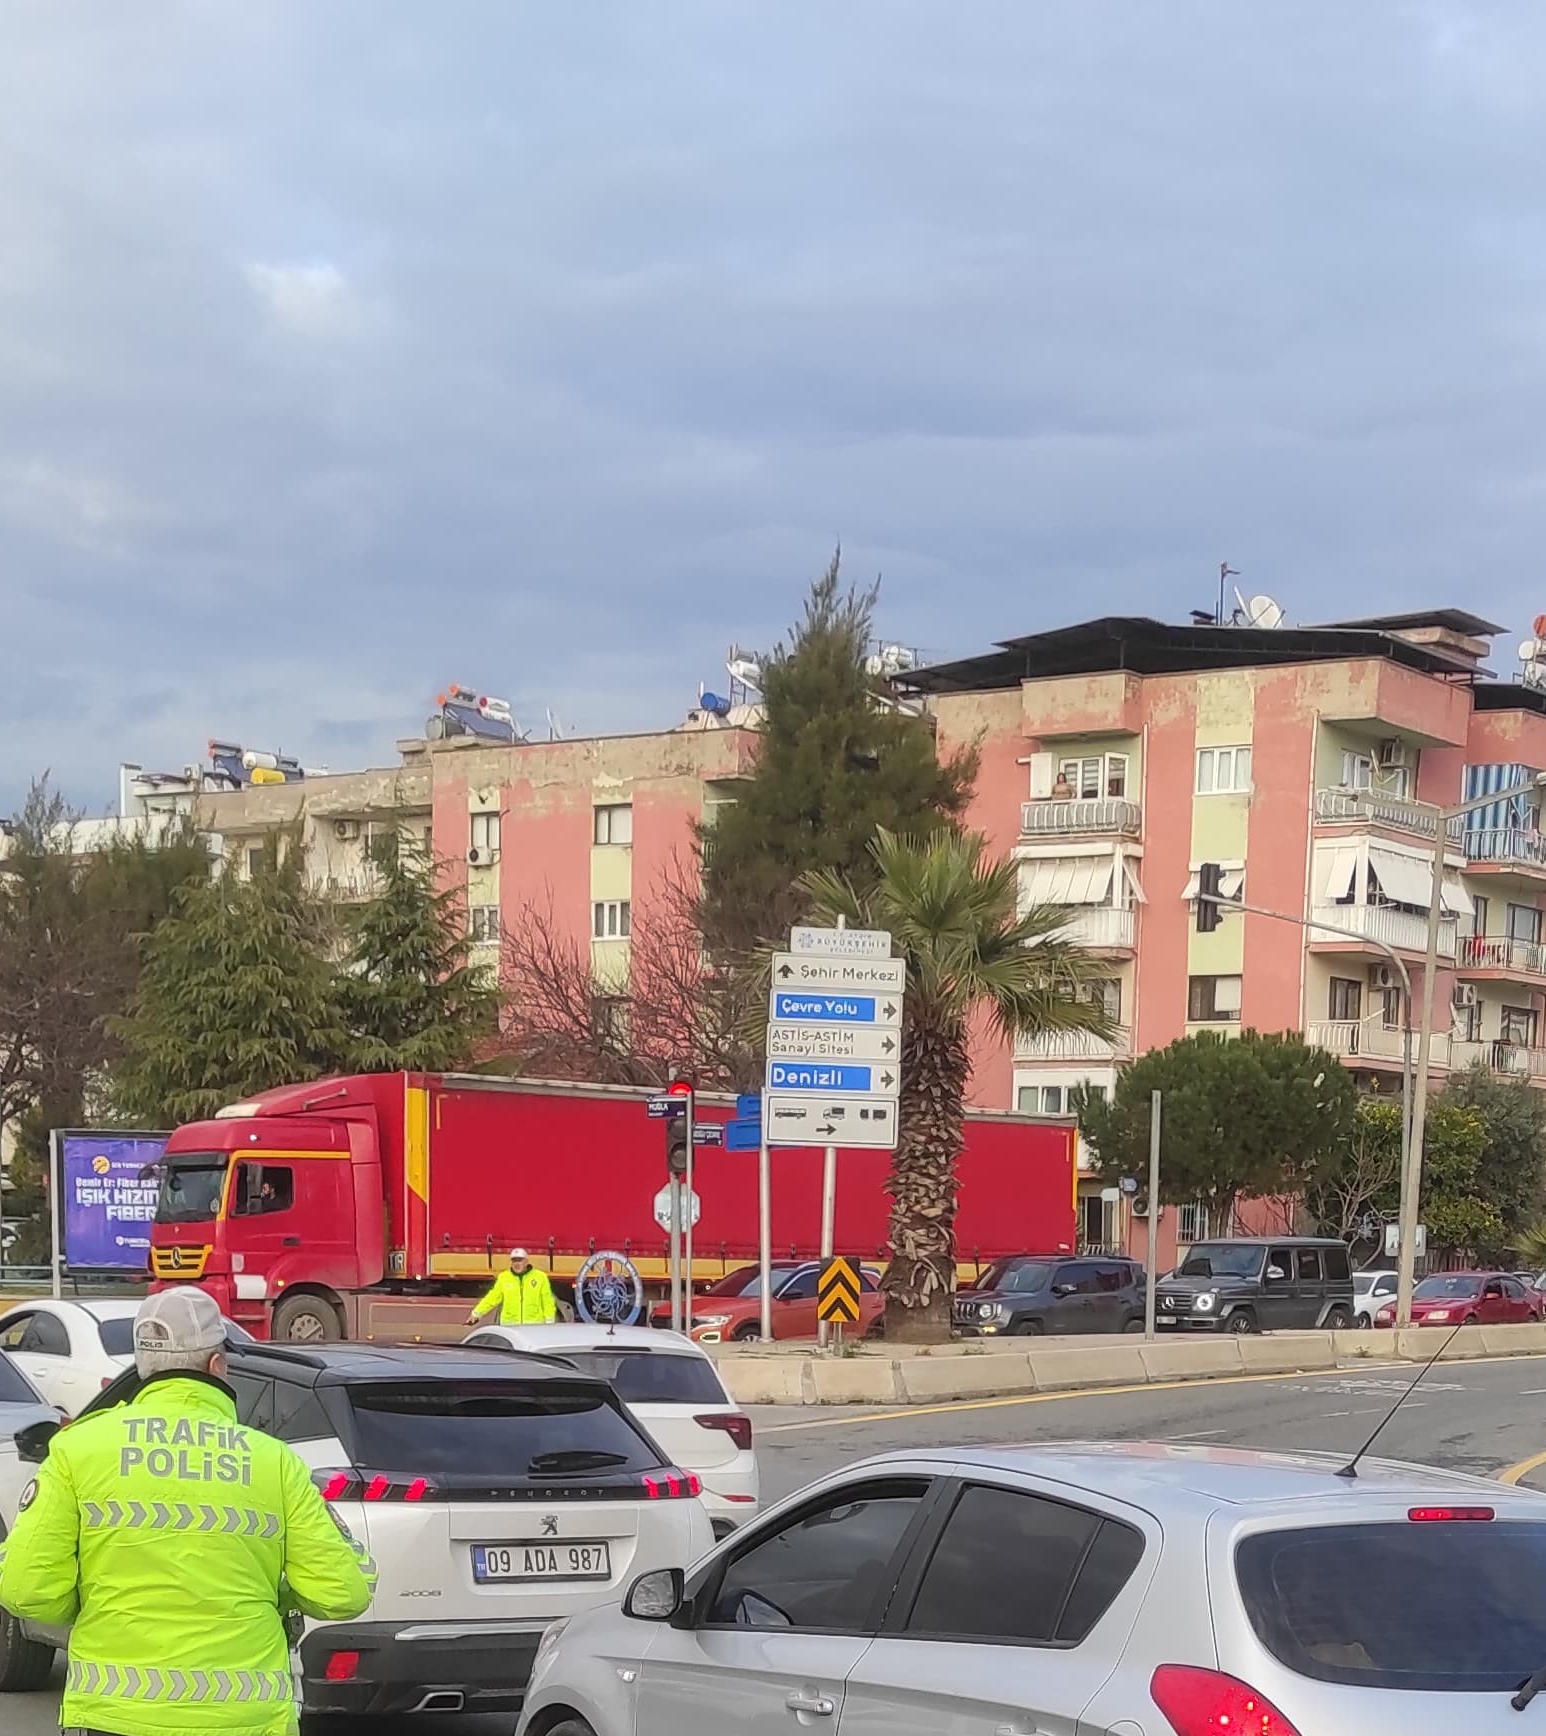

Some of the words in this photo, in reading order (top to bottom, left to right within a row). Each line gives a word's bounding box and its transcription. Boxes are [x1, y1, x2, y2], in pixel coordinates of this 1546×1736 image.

[800, 964, 839, 980] Şehir
[842, 967, 899, 982] Merkezi
[781, 998, 823, 1015] Çevre
[824, 1000, 858, 1015] Yolu
[772, 1042, 816, 1056] Sanayi
[819, 1043, 854, 1055] Sitesi
[772, 1067, 843, 1086] Denizli
[76, 1188, 111, 1207] IŞIK
[491, 1489, 603, 1498] PEUGEOT
[487, 1549, 511, 1573] 09
[523, 1549, 558, 1572] ADA
[568, 1547, 602, 1571] 987
